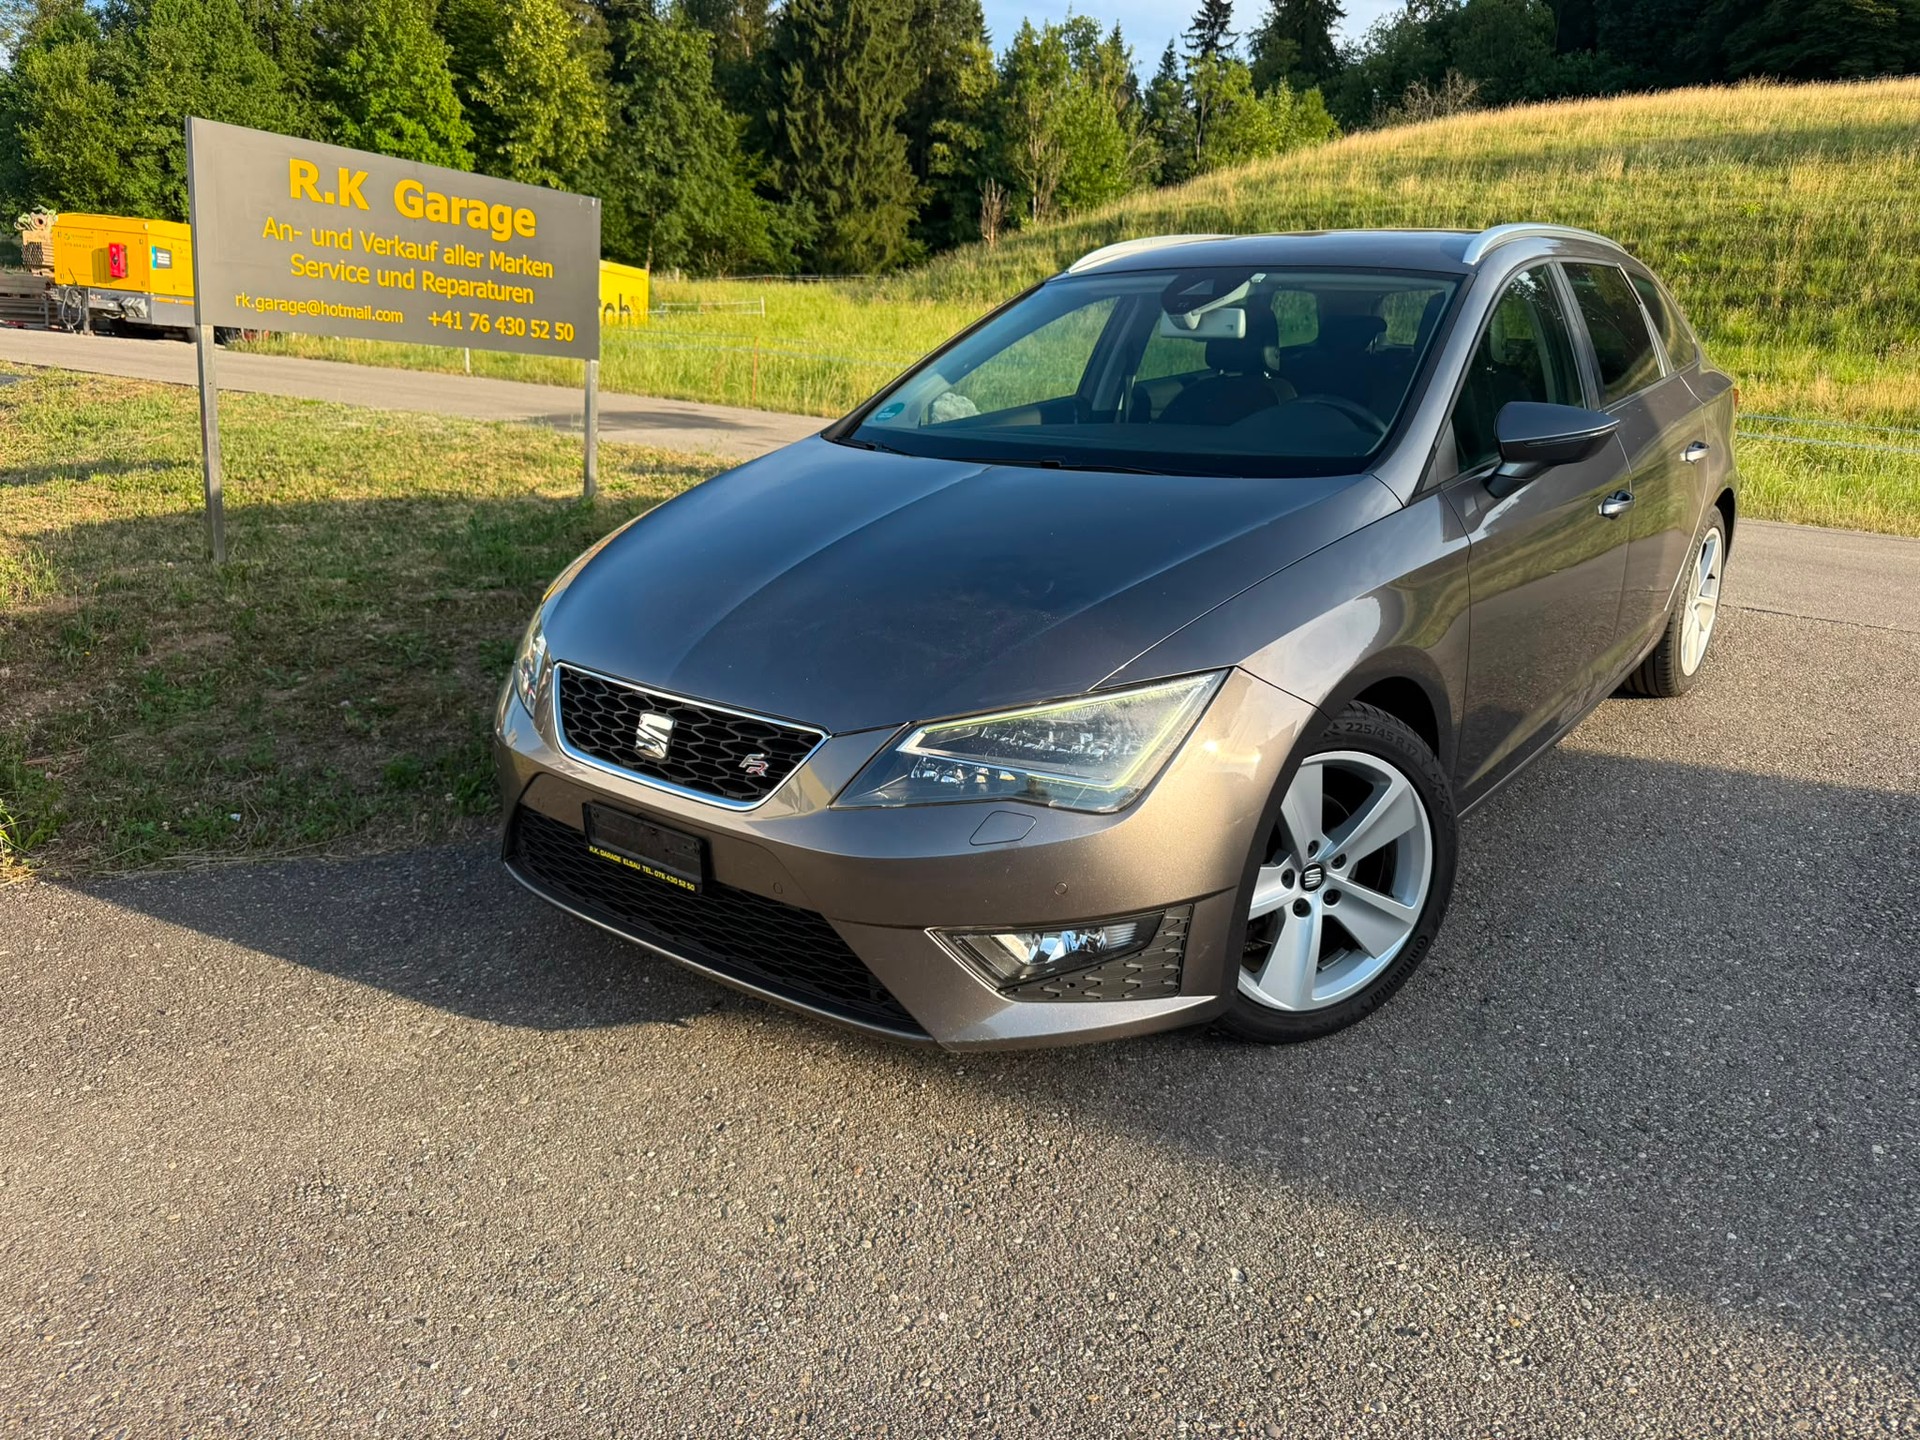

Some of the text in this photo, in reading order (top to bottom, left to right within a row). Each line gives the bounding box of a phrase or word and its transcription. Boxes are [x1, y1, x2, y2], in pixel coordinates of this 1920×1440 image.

[289, 157, 537, 243] R.K Garage
[262, 216, 554, 279] An- und Verkauf aller Marken
[290, 252, 535, 305] Service und Reparaturen
[234, 292, 404, 324] rk.garage@hotmail.com
[428, 310, 576, 343] +41 76 430 52 50
[1345, 722, 1394, 743] 225/45
[1396, 737, 1405, 750] R
[1370, 935, 1429, 1005] Continental
